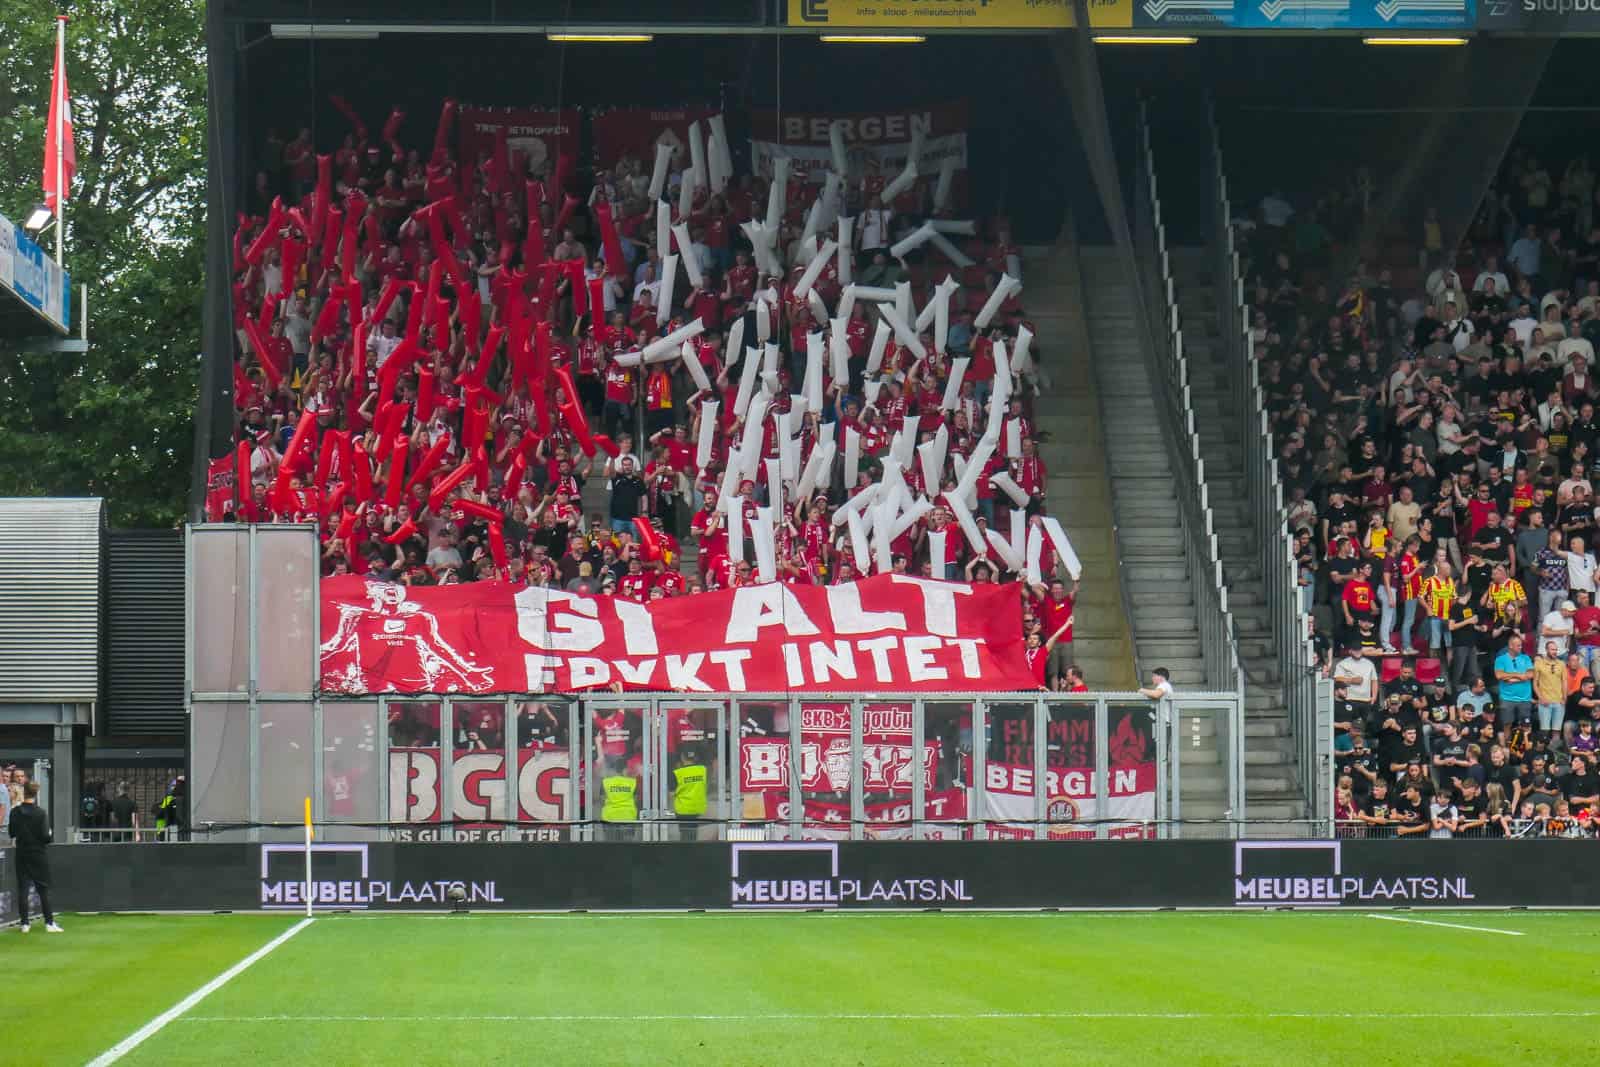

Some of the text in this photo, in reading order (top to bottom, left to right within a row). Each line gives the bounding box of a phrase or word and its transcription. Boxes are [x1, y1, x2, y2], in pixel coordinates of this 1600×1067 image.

[514, 573, 973, 656] GI ALT
[783, 634, 985, 688] INTET
[802, 709, 834, 728] SKB
[732, 879, 973, 901] MEUBELPLAATS.NL
[1235, 877, 1475, 899] MEUBELPLAATS.NL
